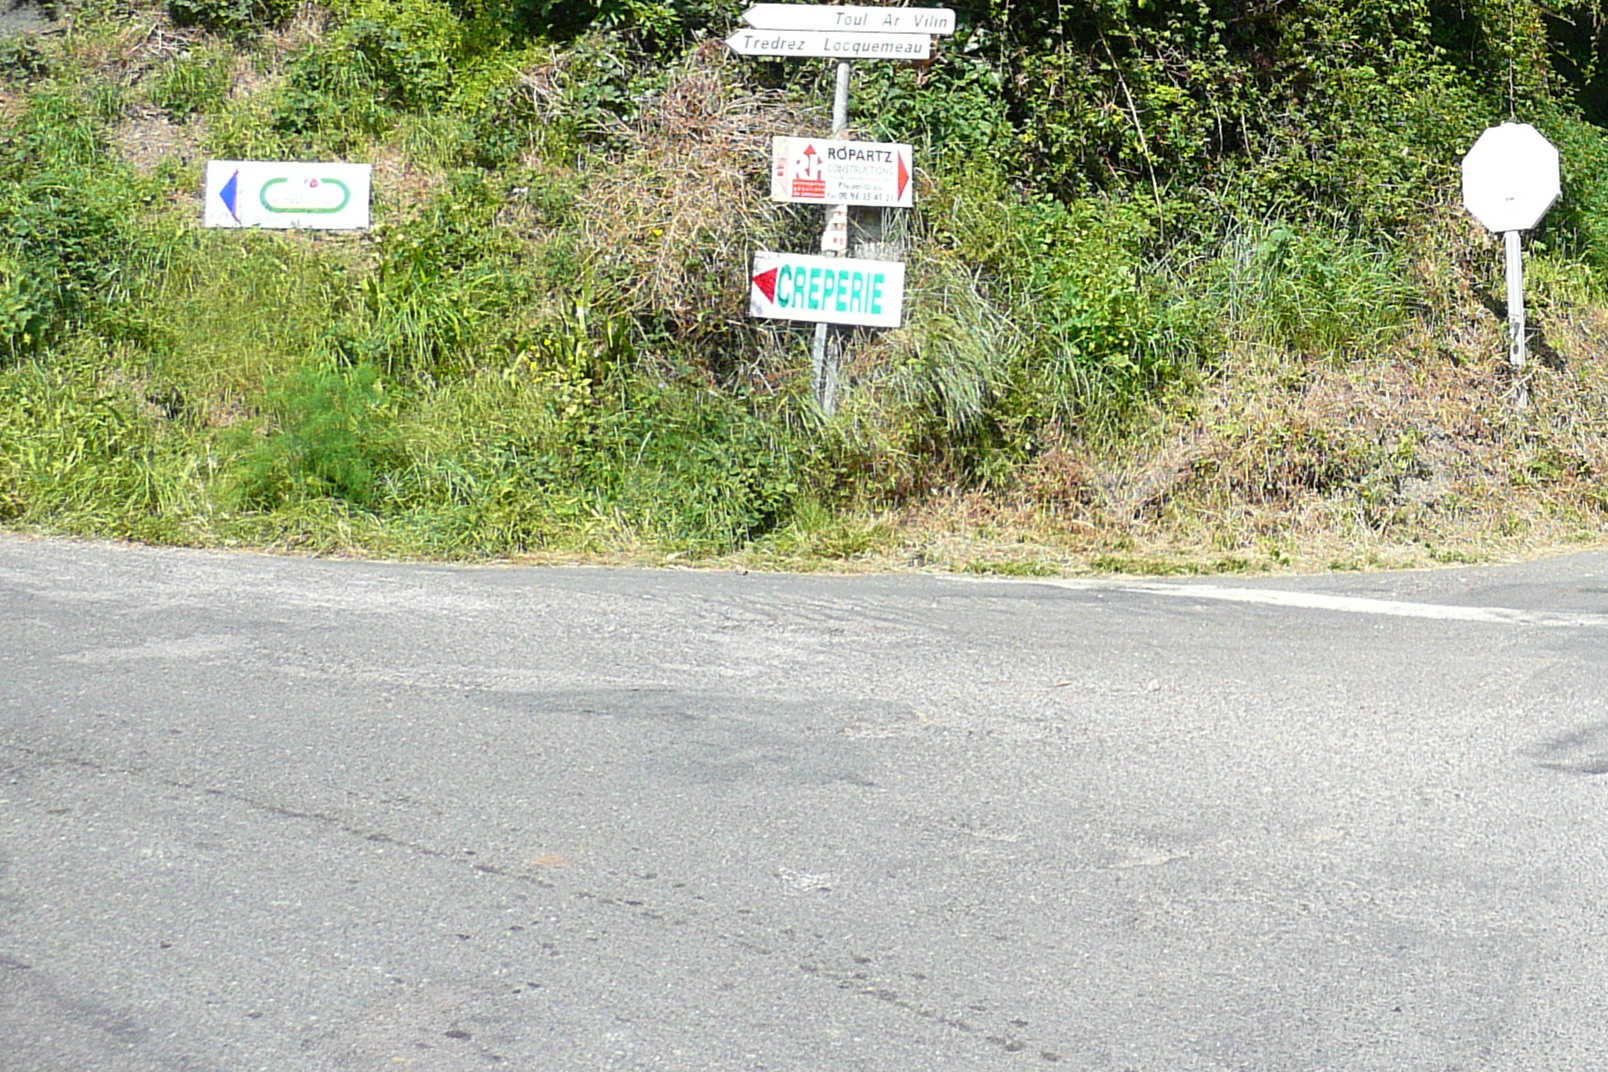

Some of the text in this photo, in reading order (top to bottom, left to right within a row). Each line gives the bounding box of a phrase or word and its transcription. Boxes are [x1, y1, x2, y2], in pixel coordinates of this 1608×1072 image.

[835, 11, 948, 28] Toul Ar Vilin
[743, 35, 923, 55] Tredrez Locquemeau
[777, 263, 885, 315] CREPERIE
